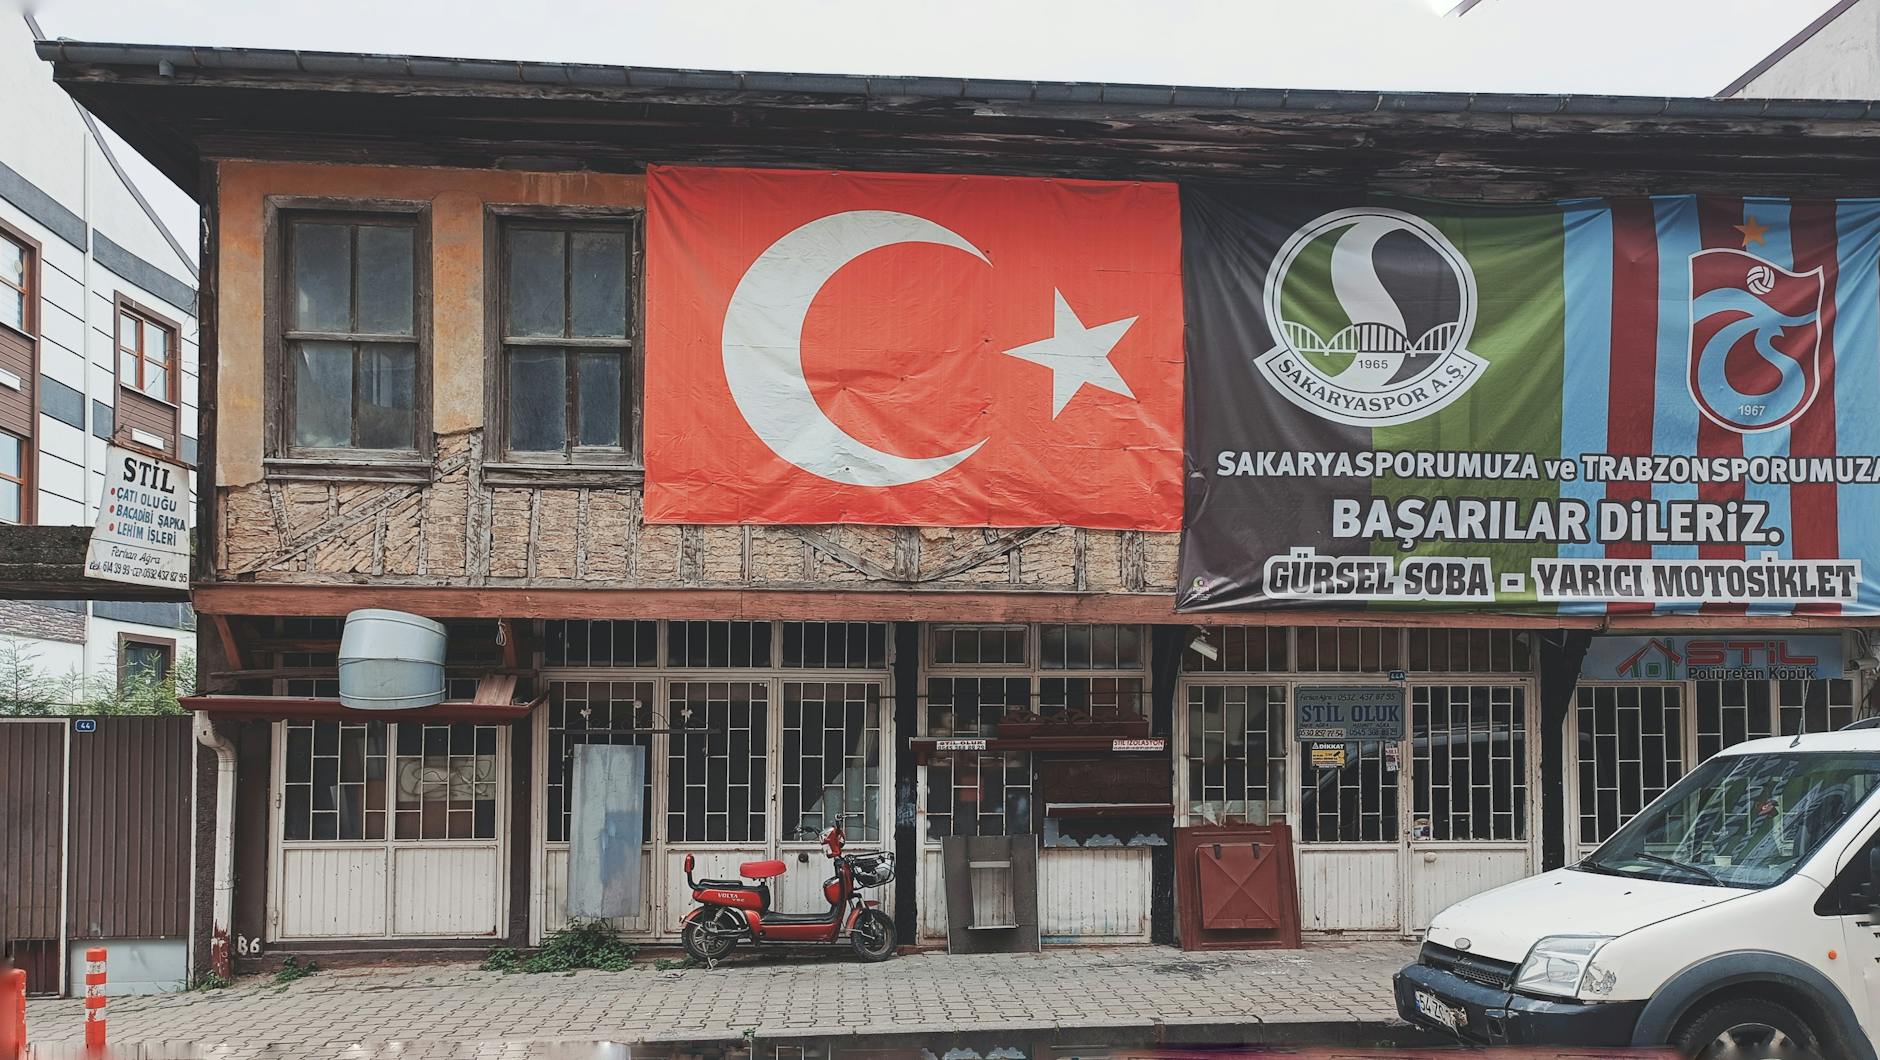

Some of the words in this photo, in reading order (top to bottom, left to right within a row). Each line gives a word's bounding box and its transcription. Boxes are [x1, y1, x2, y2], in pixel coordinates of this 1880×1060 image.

[1358, 359, 1389, 370] 1965
[1278, 359, 1429, 412] SAKARYASPOR
[1738, 404, 1766, 417] 1967
[123, 457, 175, 494] STİL
[1216, 450, 1539, 480] SAKARYASPORUMUZA
[1544, 458, 1577, 480] ve
[117, 487, 138, 503] ÇATI
[141, 493, 177, 512] OLUĞU
[117, 522, 144, 541] LEHİM
[147, 525, 177, 547] İŞLERİ
[157, 515, 186, 532] ŞAPKA
[1332, 498, 1588, 549] BAŞARILAR
[1266, 550, 1396, 597] GÜRSEL
[1402, 561, 1490, 597] SOBA
[1536, 562, 1643, 598] YARICI
[1652, 554, 1858, 599] MOTOSİKLET
[1301, 702, 1345, 722] STİL
[1350, 704, 1401, 722] OLUK
